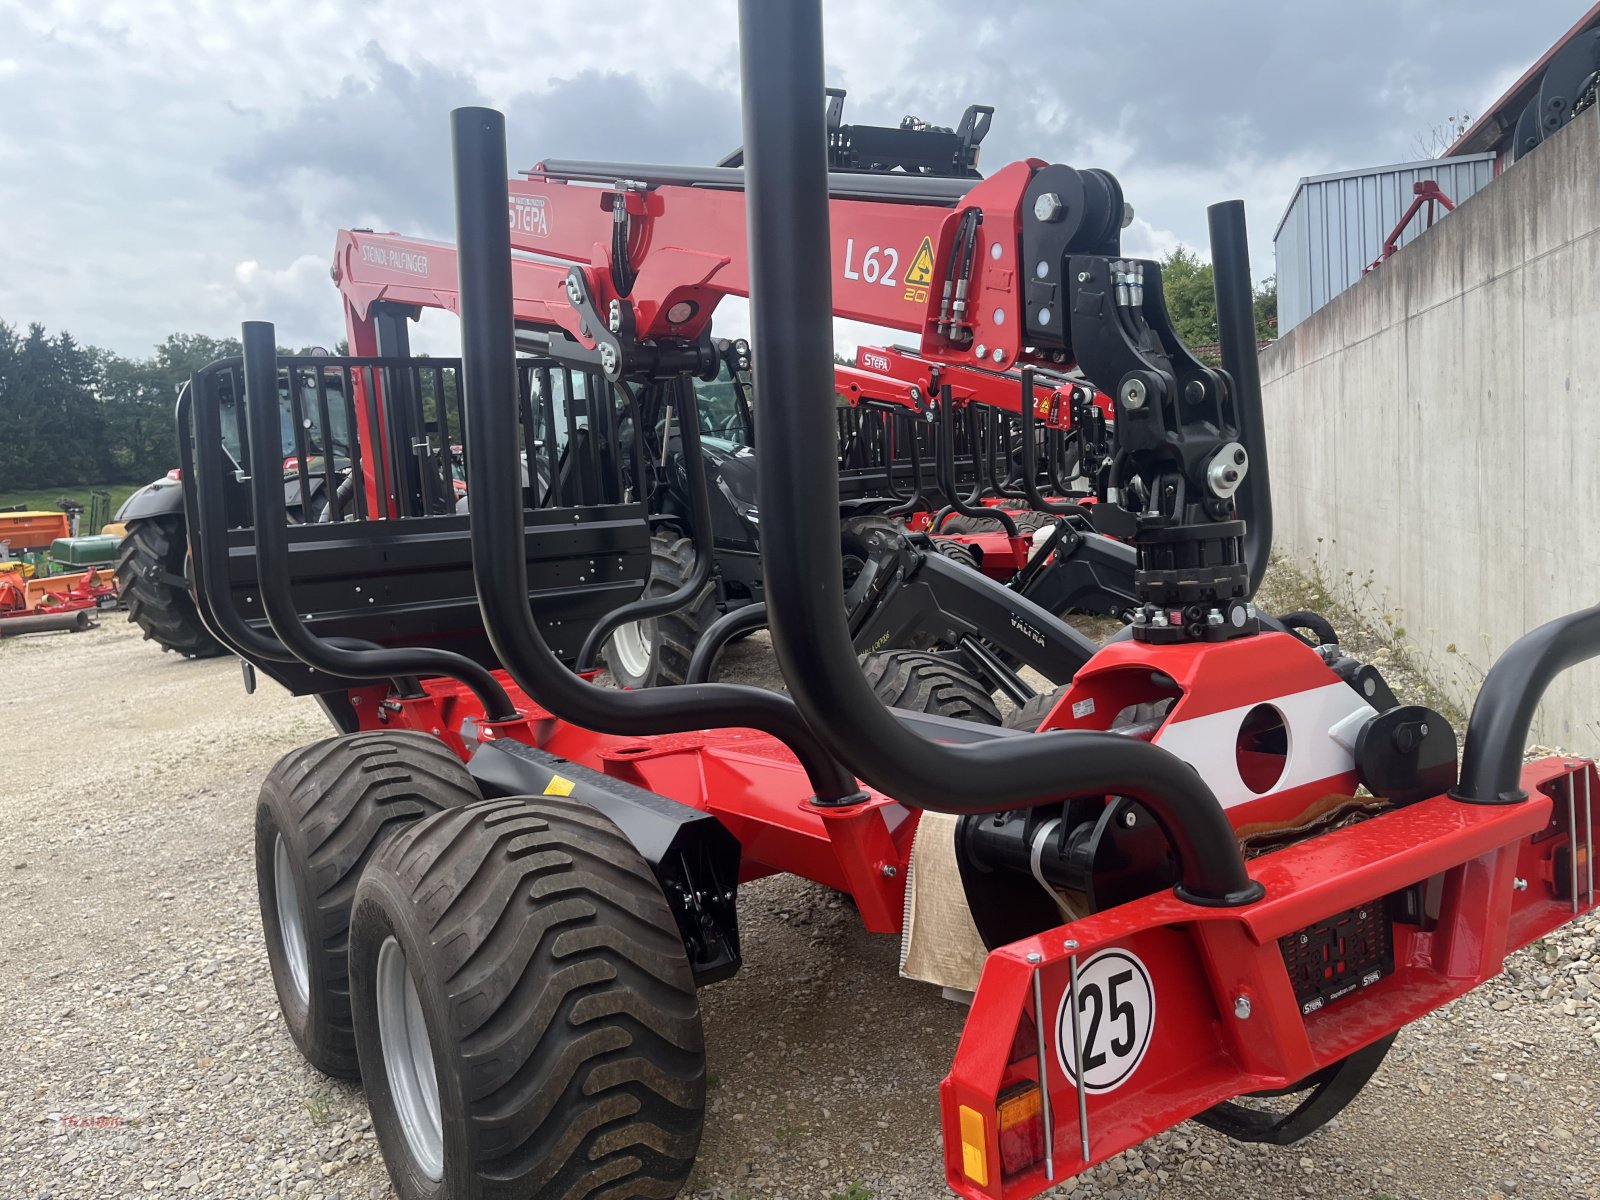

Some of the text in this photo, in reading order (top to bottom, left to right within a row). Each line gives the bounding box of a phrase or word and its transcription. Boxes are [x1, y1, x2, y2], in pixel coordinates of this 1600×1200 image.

[362, 245, 428, 274] STEINDL-PALFINGER
[844, 238, 898, 287] L62
[904, 288, 928, 303] 20
[864, 353, 888, 370] STEPA
[1011, 612, 1046, 648] VALTRA
[1078, 968, 1136, 1072] 25
